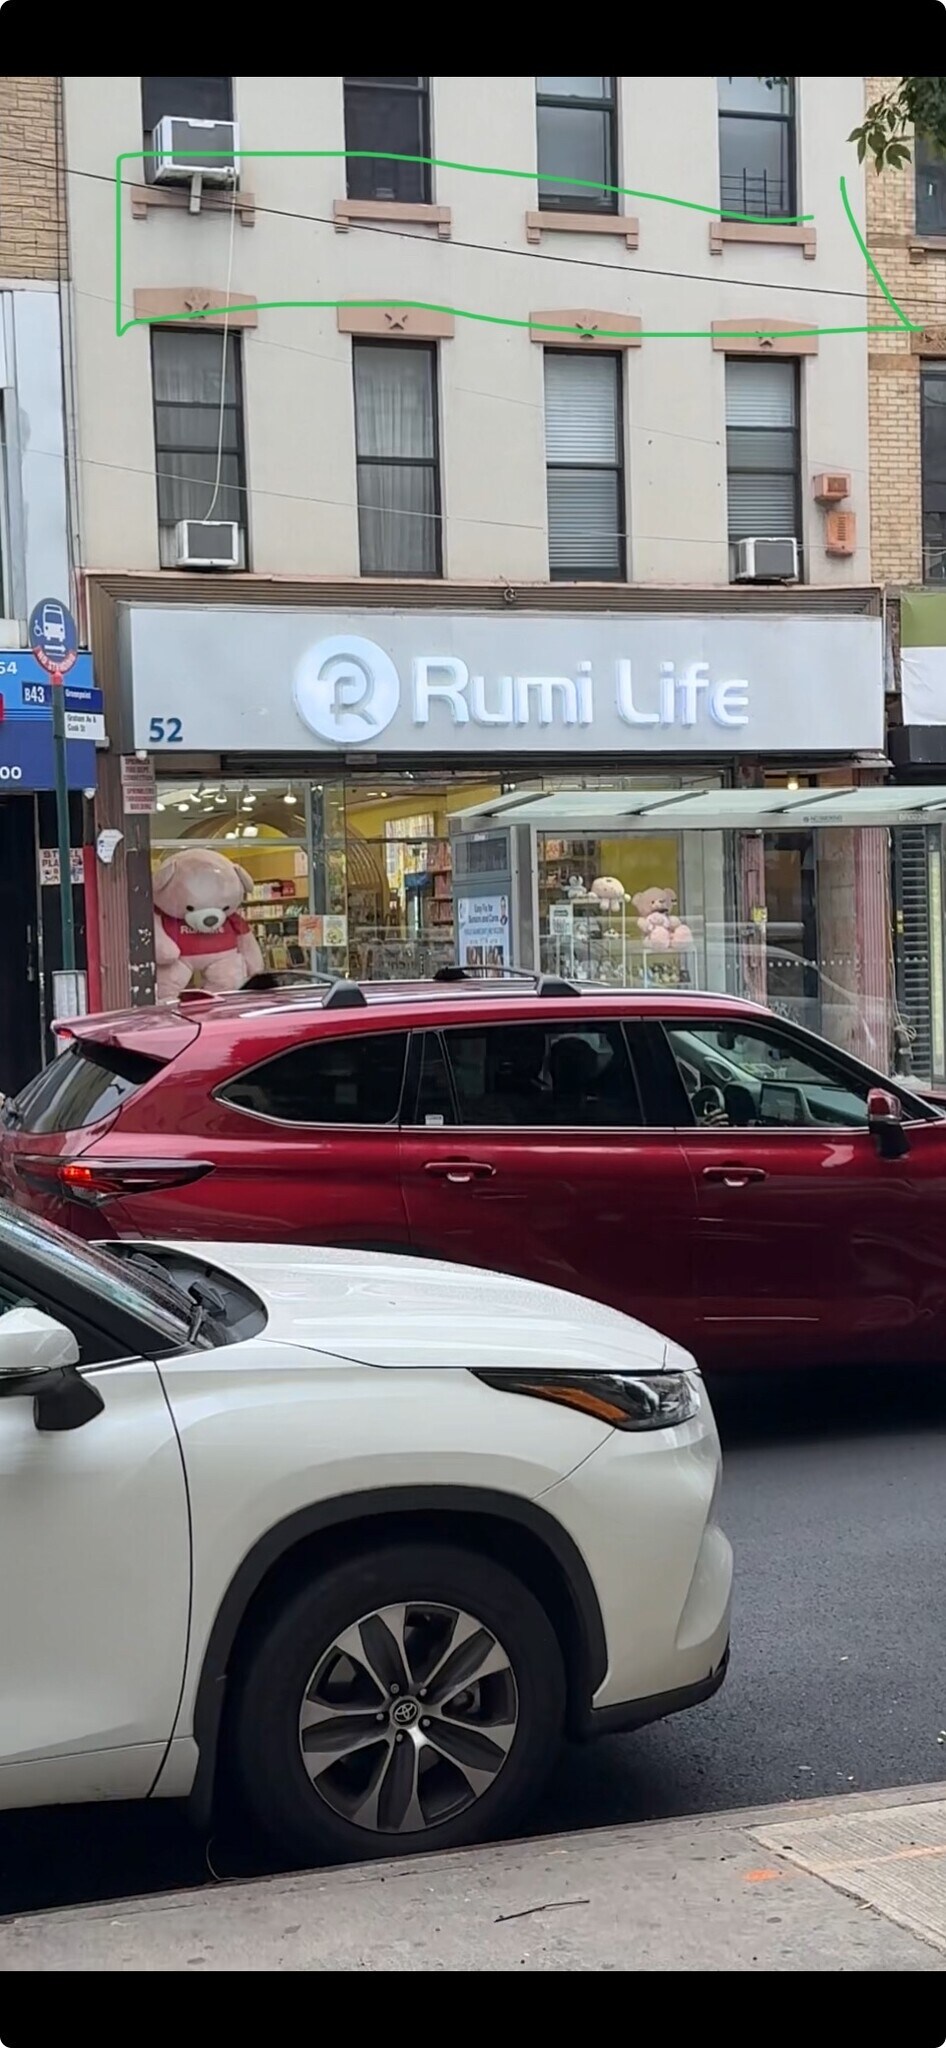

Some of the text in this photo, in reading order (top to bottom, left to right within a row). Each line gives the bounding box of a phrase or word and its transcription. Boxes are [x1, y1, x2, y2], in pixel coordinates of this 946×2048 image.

[24, 685, 45, 703] B43
[65, 688, 92, 700] Greenpoint
[412, 656, 750, 728] Rumi Life
[149, 717, 183, 743] 52
